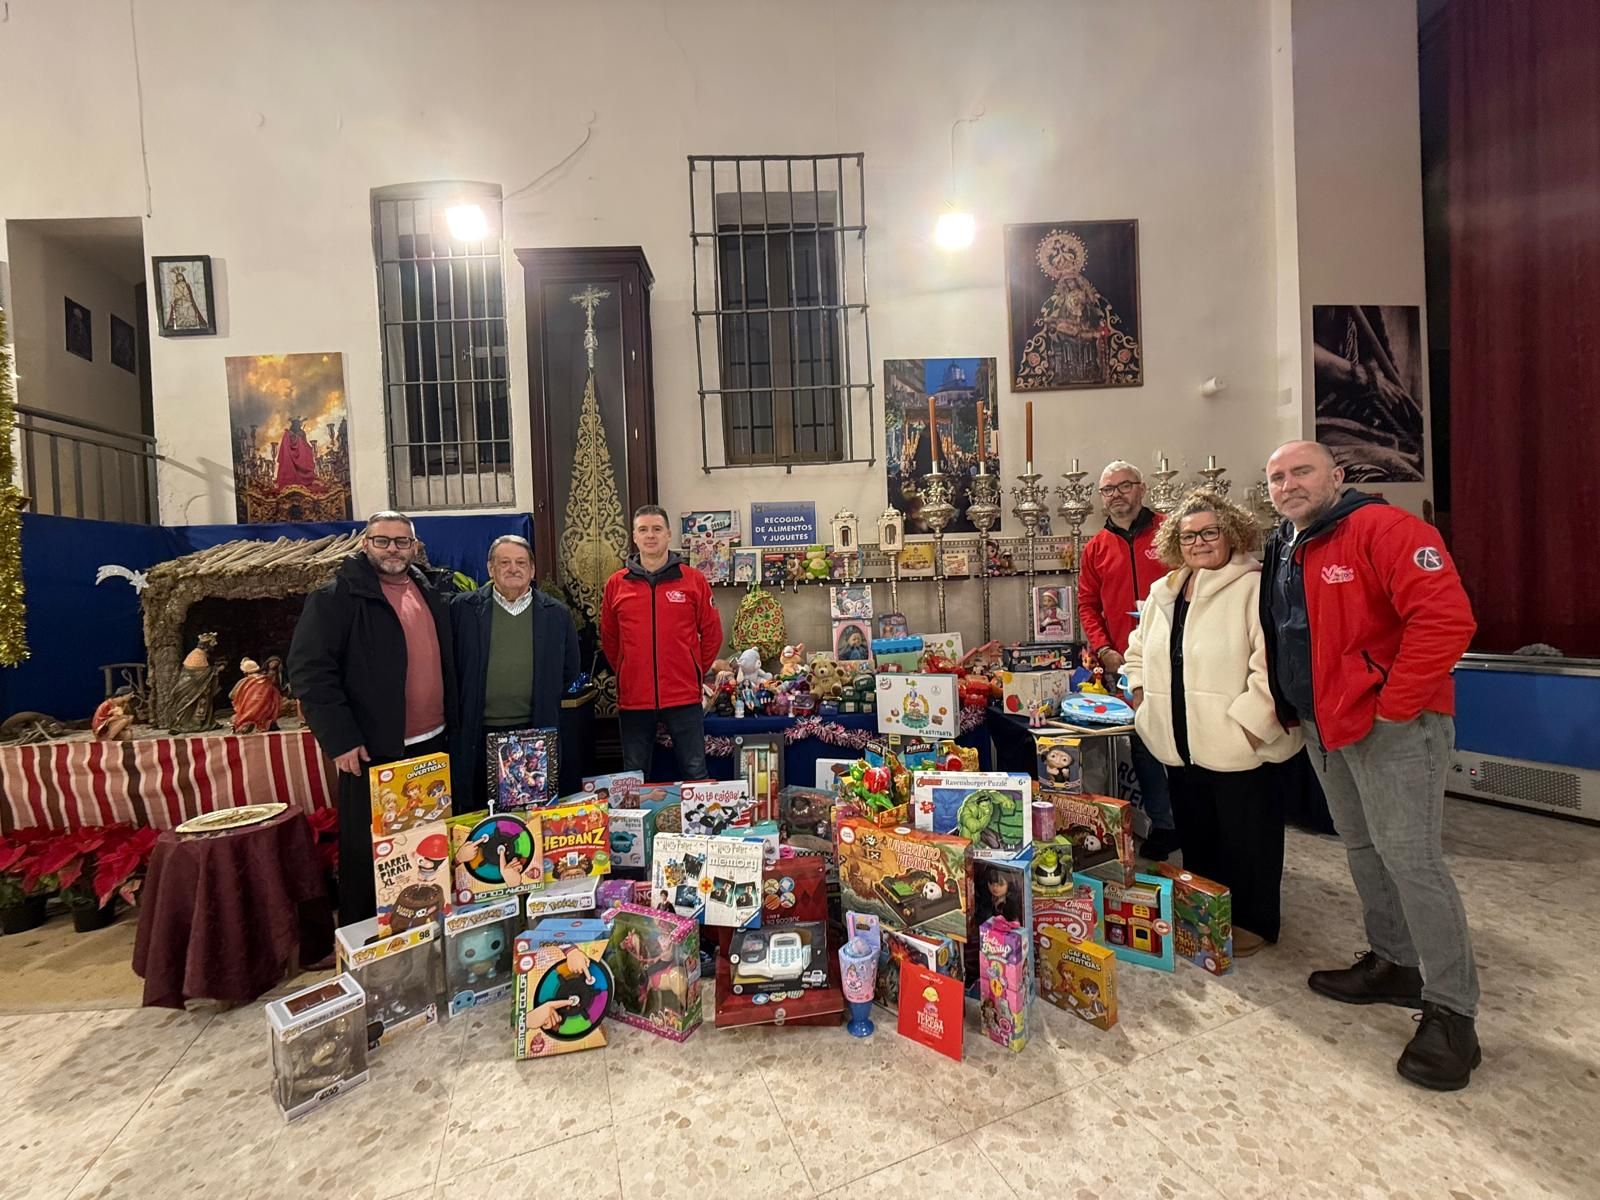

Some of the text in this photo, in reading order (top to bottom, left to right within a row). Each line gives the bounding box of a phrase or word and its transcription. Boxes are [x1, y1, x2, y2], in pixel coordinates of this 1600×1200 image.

[764, 515, 805, 524] RECOGIDA
[768, 524, 813, 533] ALIMENTOS
[769, 533, 809, 542] JUGUETES
[918, 729, 952, 737] PLASTITARTA
[406, 762, 447, 780] DIVERTIDAS
[413, 760, 437, 771] GAFAS
[945, 779, 986, 788] Ravensburger
[987, 779, 1008, 787] Puzzle
[693, 792, 705, 802] No
[887, 837, 941, 861] LABERINTO
[709, 858, 759, 873] memory
[897, 853, 932, 873] PIRATA
[382, 878, 396, 889] XL
[474, 882, 542, 900] MEMORY COLOR
[418, 929, 430, 941] 98
[1061, 952, 1101, 971] DIVERTIDAS
[1068, 949, 1092, 962] GAFAS
[518, 973, 527, 1056] MEMORY COLOR
